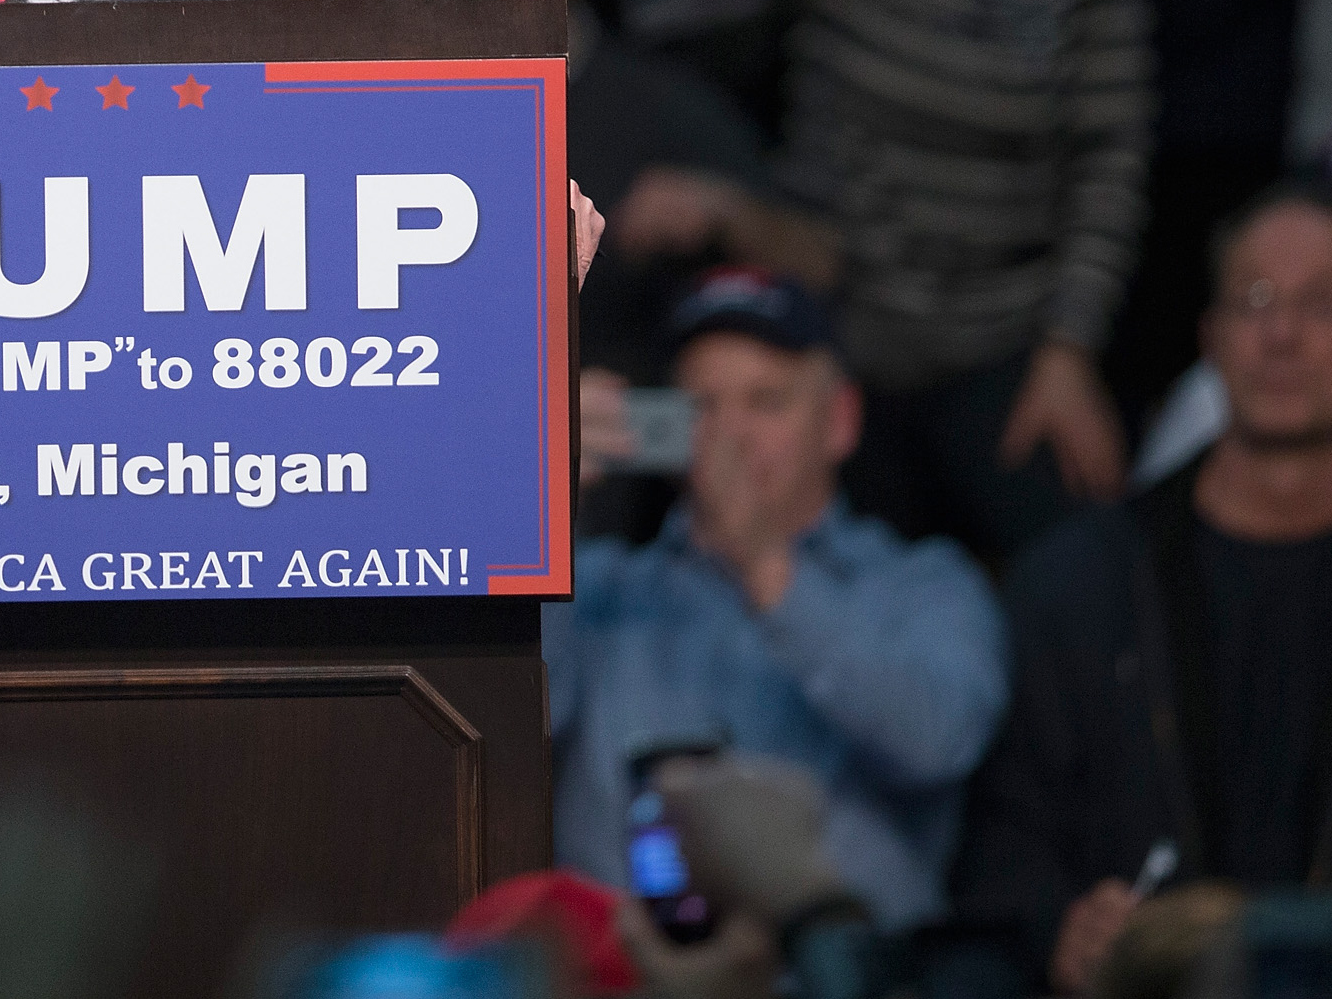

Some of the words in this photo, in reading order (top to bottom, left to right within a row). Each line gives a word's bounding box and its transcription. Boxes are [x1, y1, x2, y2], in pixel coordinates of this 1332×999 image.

[136, 347, 193, 391] to
[212, 335, 441, 389] 88022
[37, 441, 368, 508] Michigan
[82, 551, 263, 591] GREAT
[277, 548, 469, 588] AGAIN!
